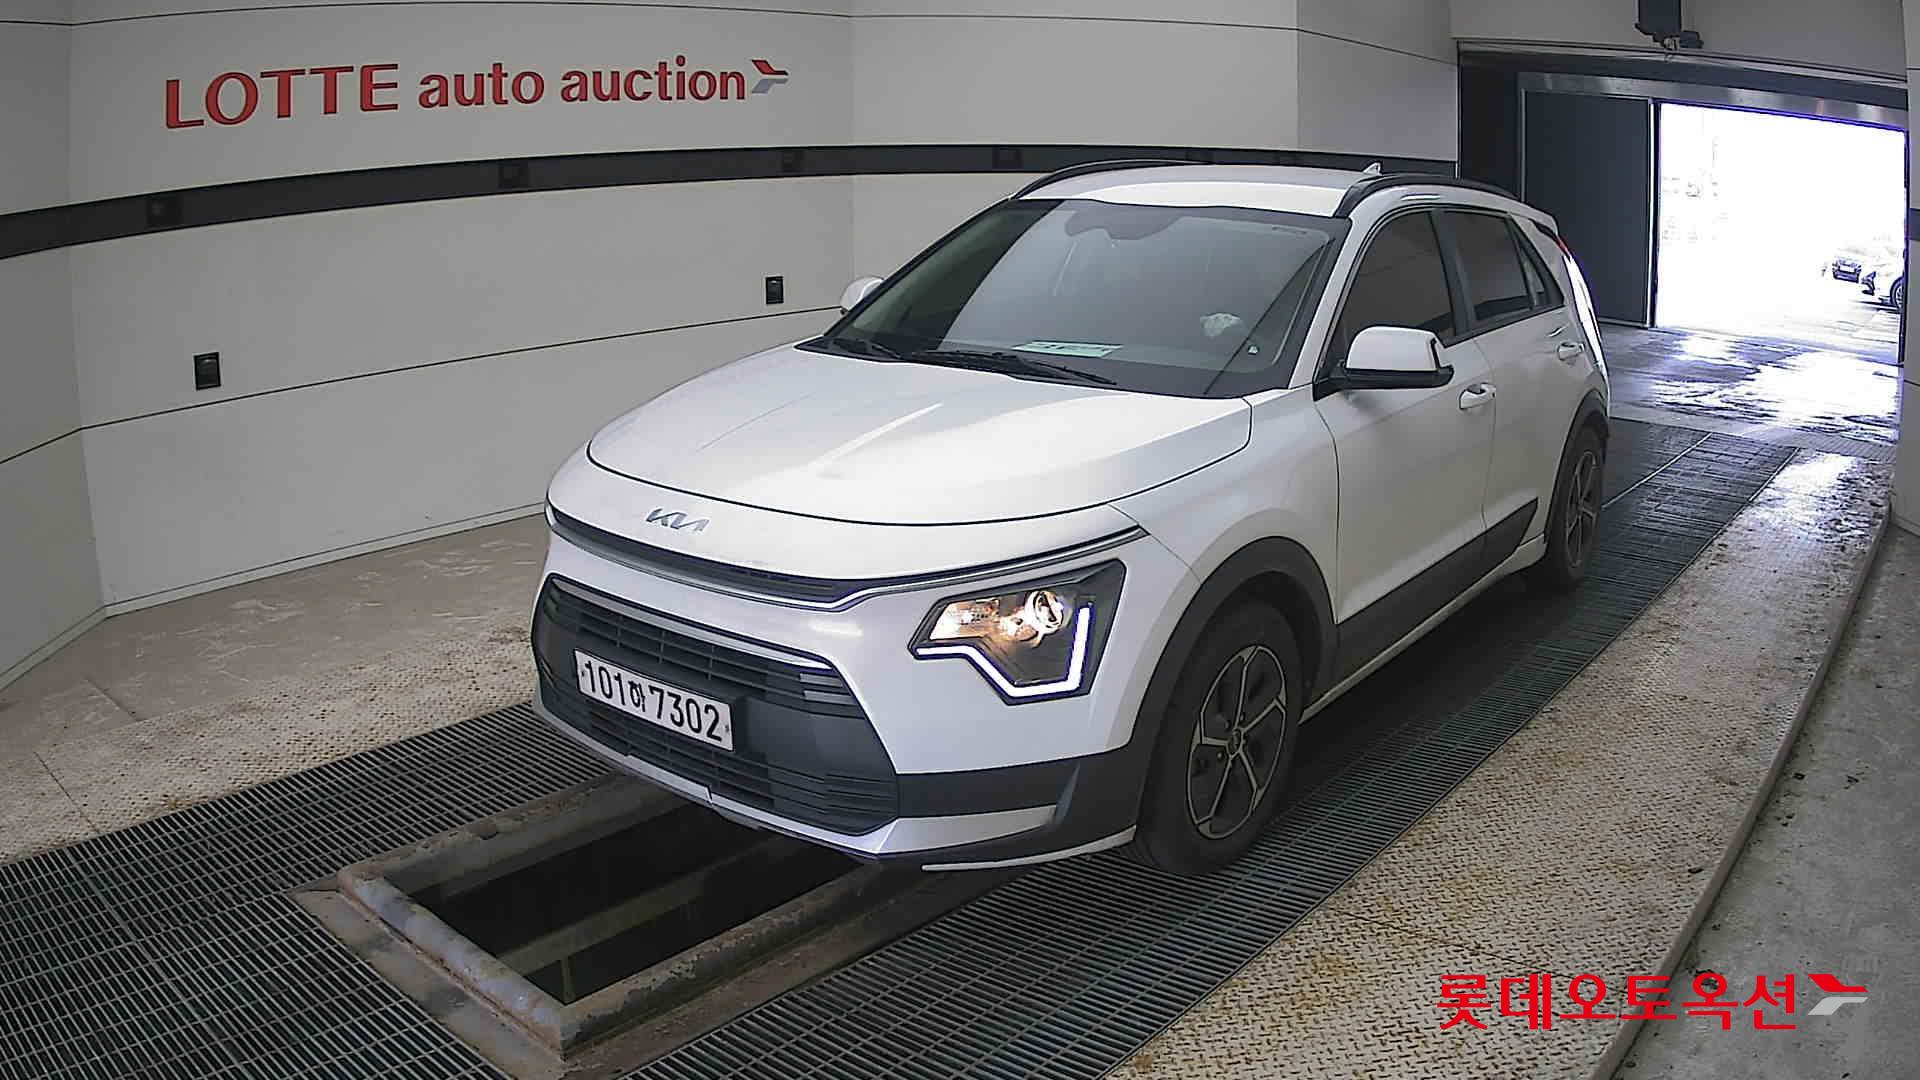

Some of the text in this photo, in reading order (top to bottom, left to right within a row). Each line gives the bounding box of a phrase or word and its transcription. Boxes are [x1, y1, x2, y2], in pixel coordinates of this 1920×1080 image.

[165, 55, 746, 129] LOTTE auto auction
[646, 508, 710, 532] KIA
